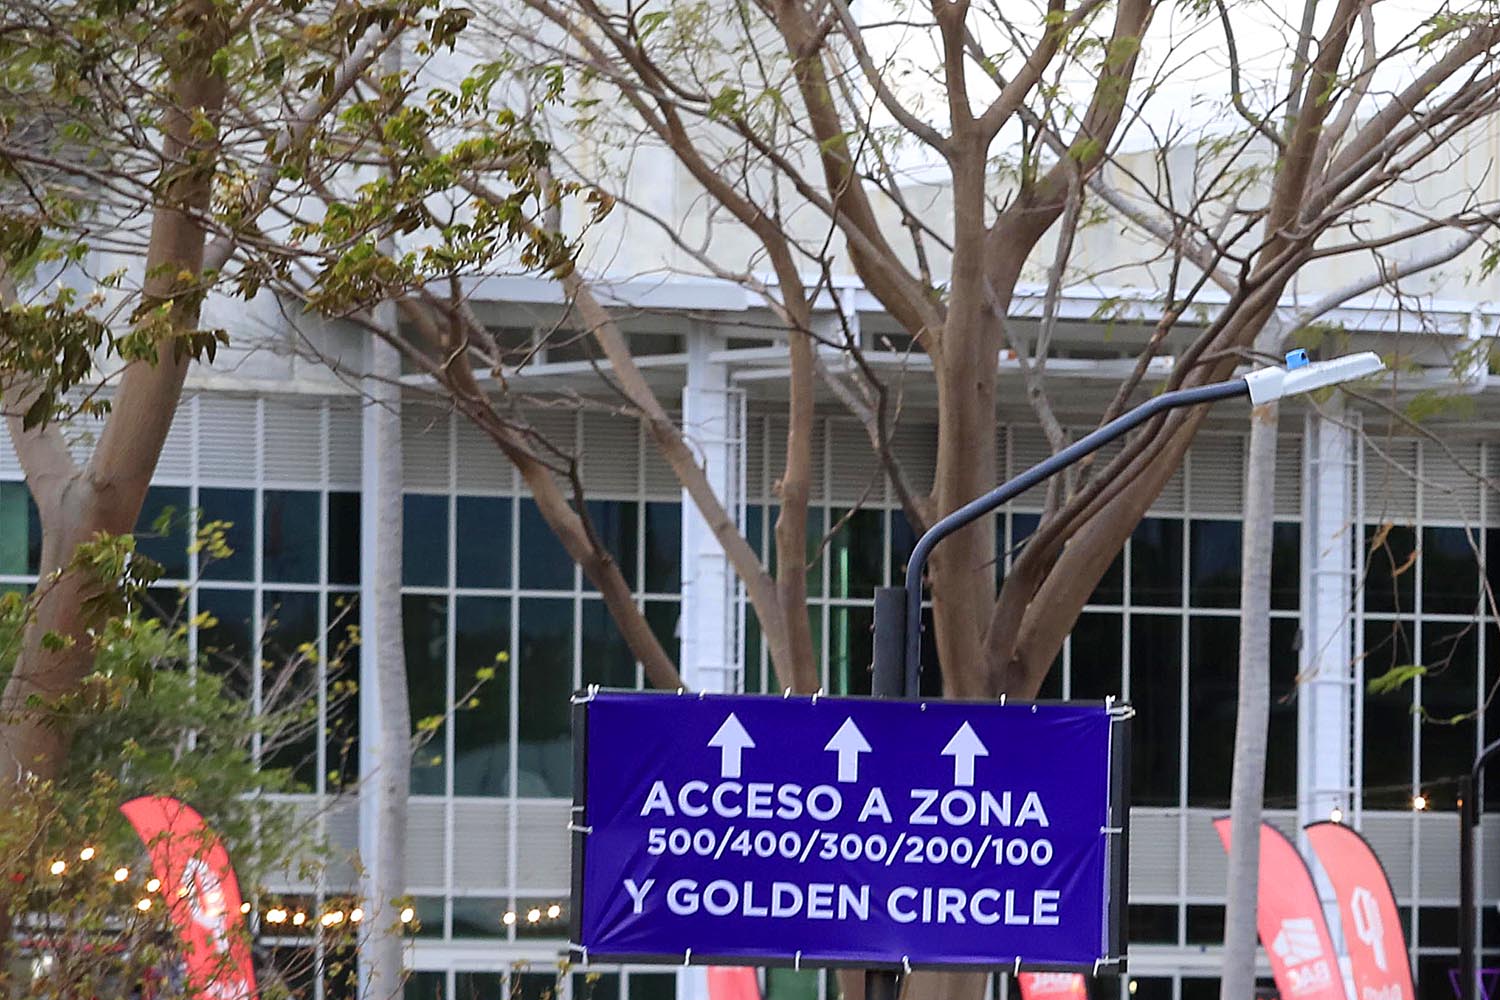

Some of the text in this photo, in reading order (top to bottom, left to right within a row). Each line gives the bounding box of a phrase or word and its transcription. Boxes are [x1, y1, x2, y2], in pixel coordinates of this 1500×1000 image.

[640, 780, 1050, 827] ACCESO A ZONA
[647, 826, 1054, 869] 500/400/300/200/100
[623, 878, 1061, 926] Y GOLDEN CIRCLE
